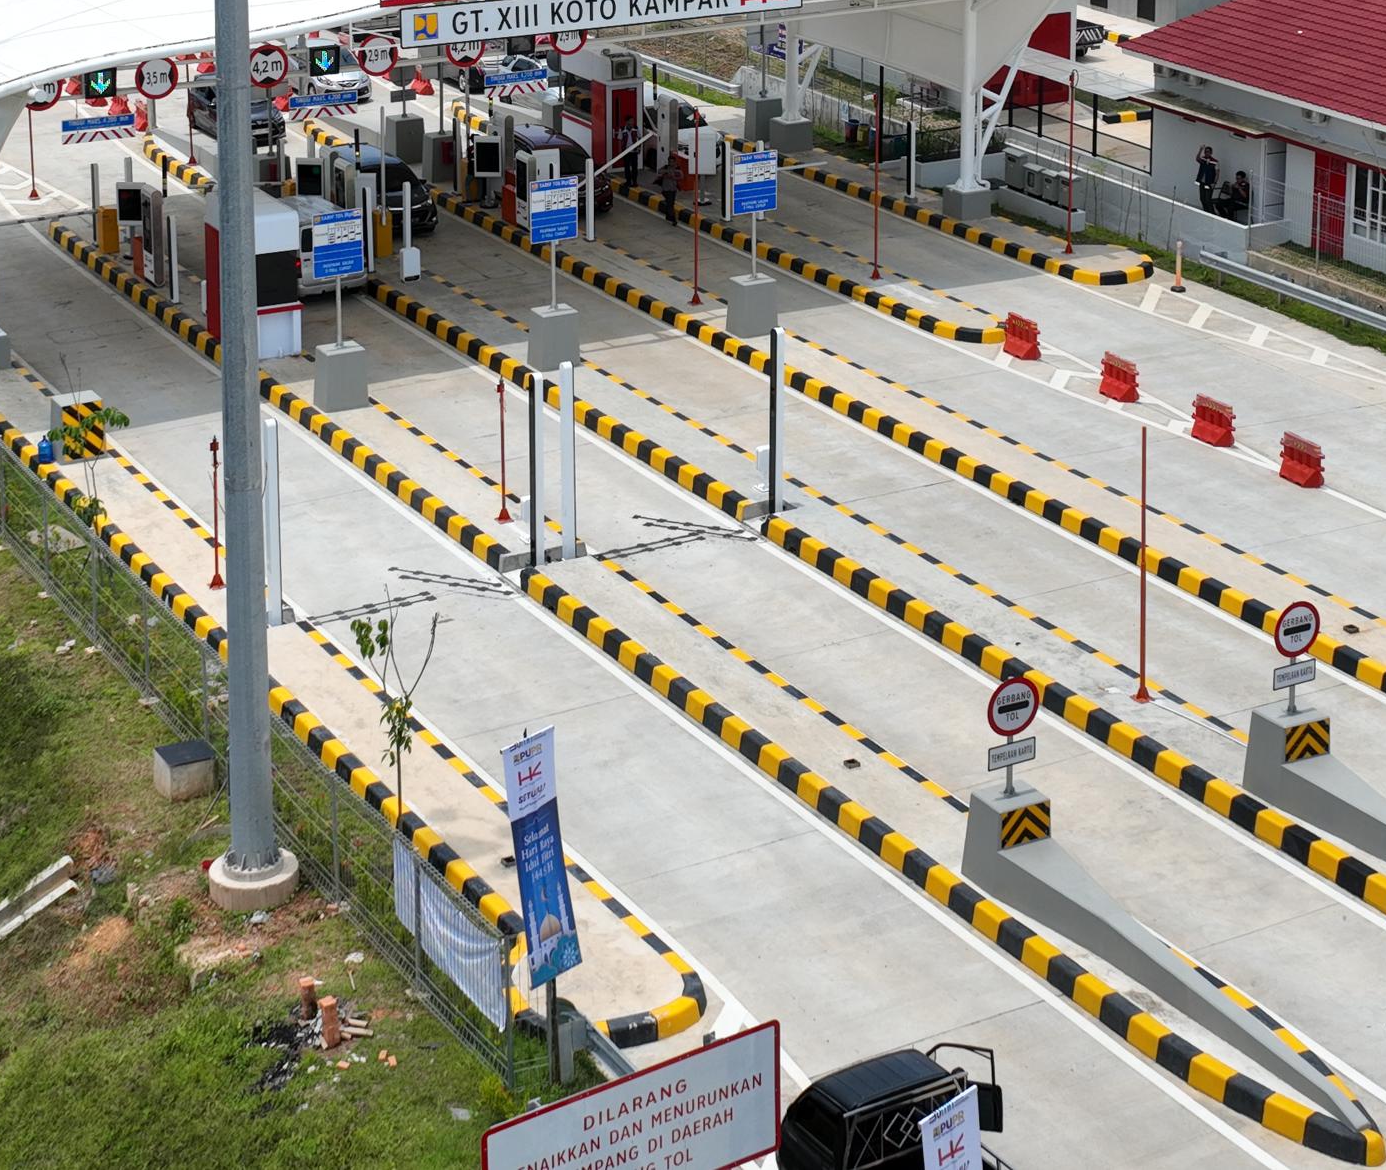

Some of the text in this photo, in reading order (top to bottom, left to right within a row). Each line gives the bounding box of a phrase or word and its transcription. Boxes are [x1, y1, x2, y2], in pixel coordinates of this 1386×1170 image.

[452, 9, 489, 35] GT.
[498, 4, 538, 31] XIII
[368, 49, 388, 62] 2,9 m
[159, 71, 168, 83] m
[252, 60, 282, 76] 4,2 m
[1282, 613, 1313, 628] GERBANG
[1290, 634, 1302, 643] TOL
[997, 690, 1031, 706] GERBANG
[1006, 711, 1019, 722] TOL
[524, 823, 549, 846] Selamat
[521, 835, 554, 860] Hari Raya
[525, 855, 540, 873] Idul
[583, 1079, 688, 1131] DILARANG
[609, 1119, 643, 1145] DAN
[651, 1073, 763, 1128] MENURUNKAN
[648, 1138, 663, 1153] DI
[672, 1107, 734, 1144] DAERAH
[664, 1148, 693, 1168] TOL
